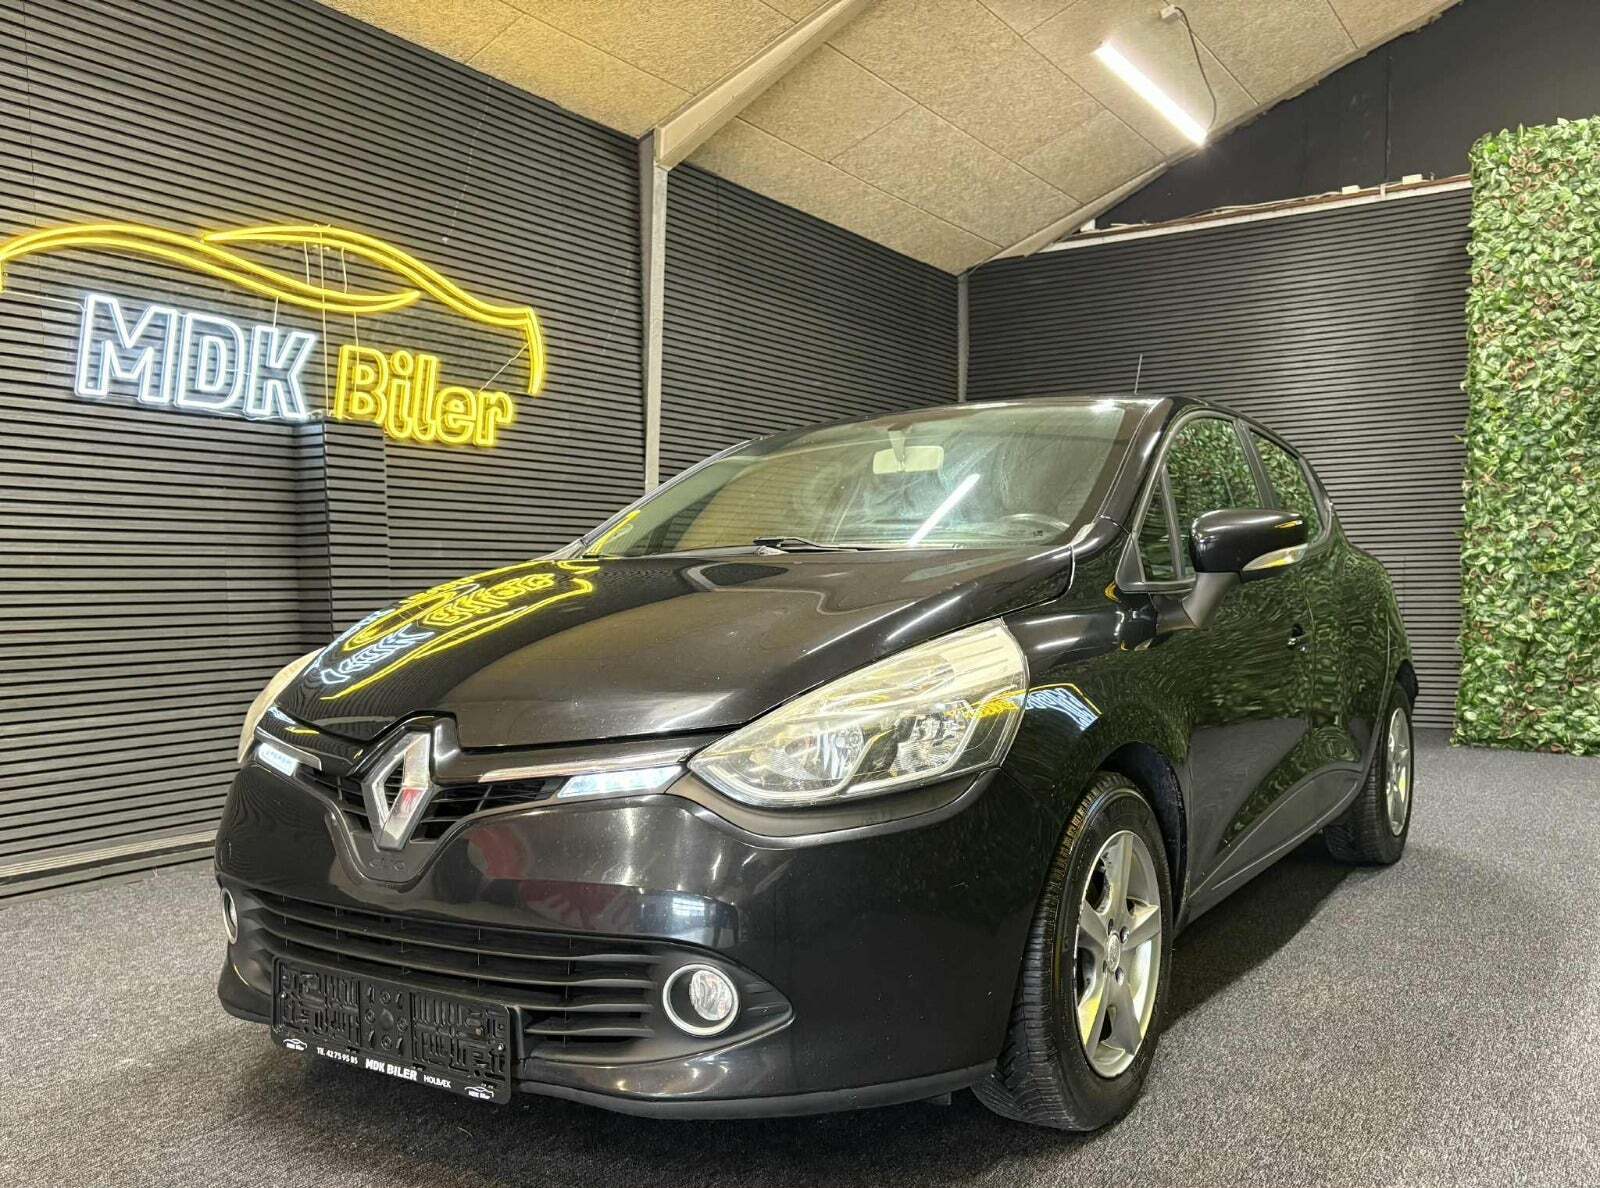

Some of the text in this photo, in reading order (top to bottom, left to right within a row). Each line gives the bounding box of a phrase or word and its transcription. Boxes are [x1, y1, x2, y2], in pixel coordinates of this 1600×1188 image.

[75, 293, 514, 446] MDK Biler
[365, 1058, 417, 1081] MDK BILER
